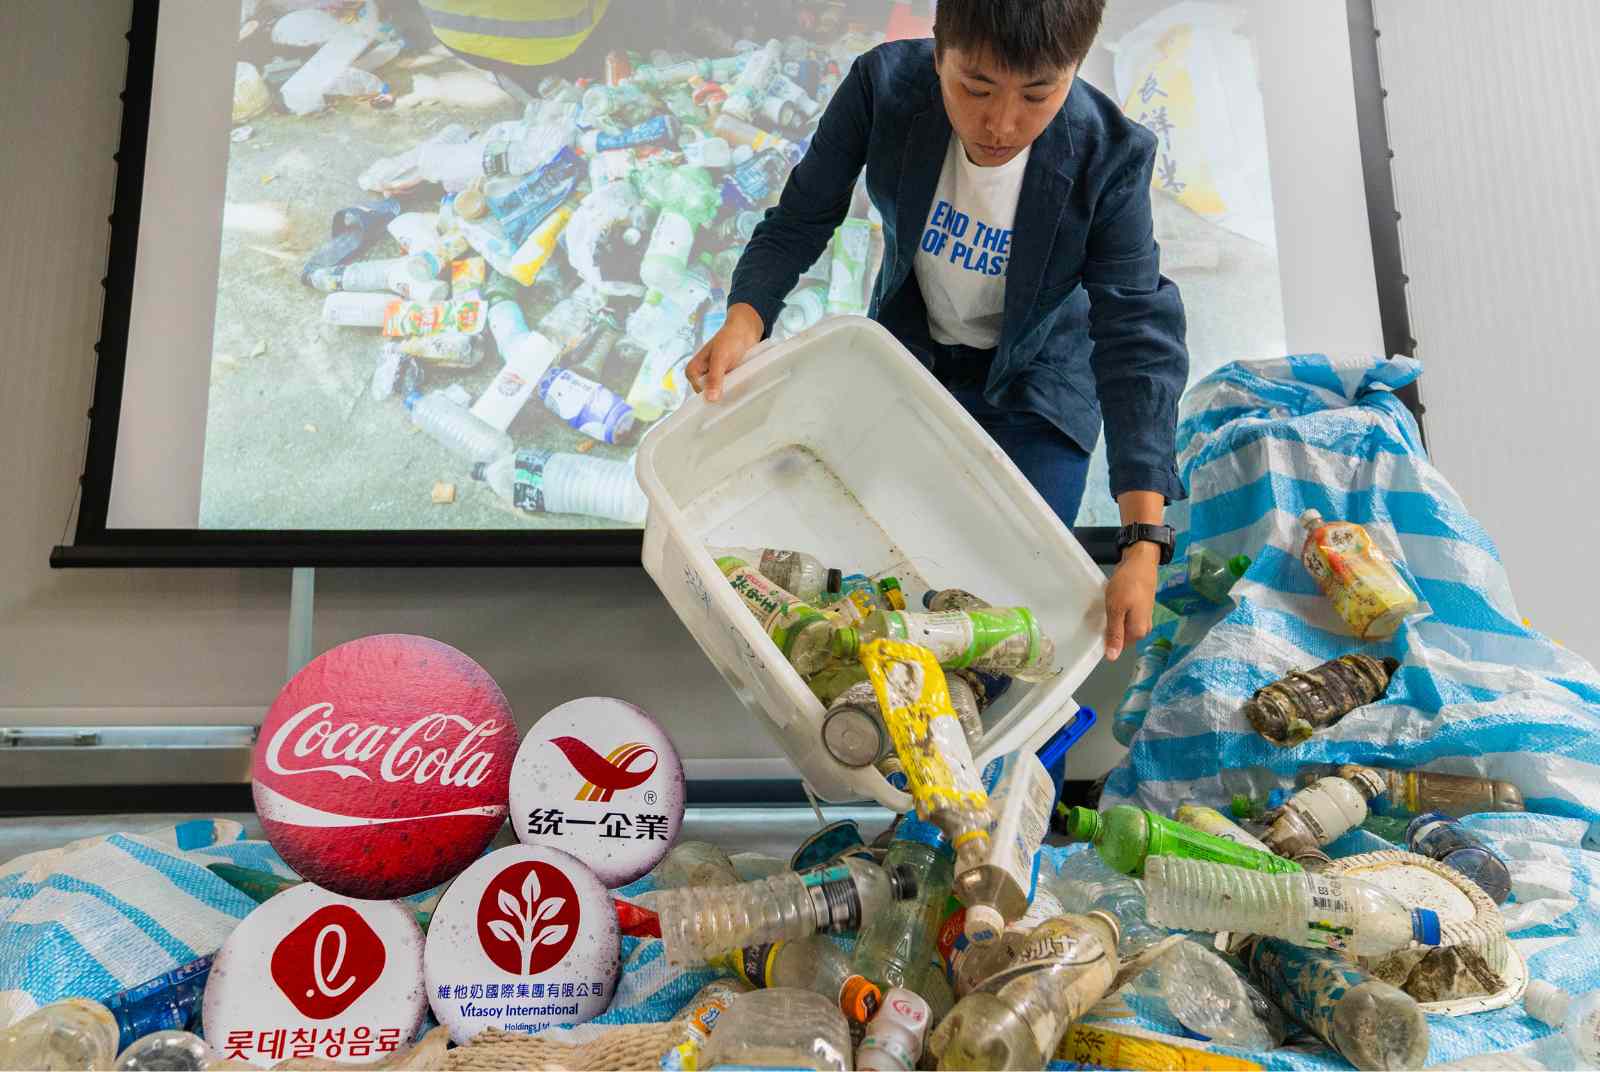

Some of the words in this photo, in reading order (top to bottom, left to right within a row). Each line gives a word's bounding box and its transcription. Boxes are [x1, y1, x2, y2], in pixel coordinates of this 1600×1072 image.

[930, 200, 970, 238] END
[972, 220, 1012, 254] THE
[921, 229, 949, 256] OF
[265, 702, 505, 788] Coca-Cola
[527, 808, 669, 841] 統一企業
[437, 982, 604, 1000] 維他奶國際集團有限公司
[460, 1002, 503, 1019] Vitasoy
[506, 1003, 579, 1017] International
[504, 1022, 537, 1034] Holdings
[224, 1026, 401, 1061] 롯데칠성음료
